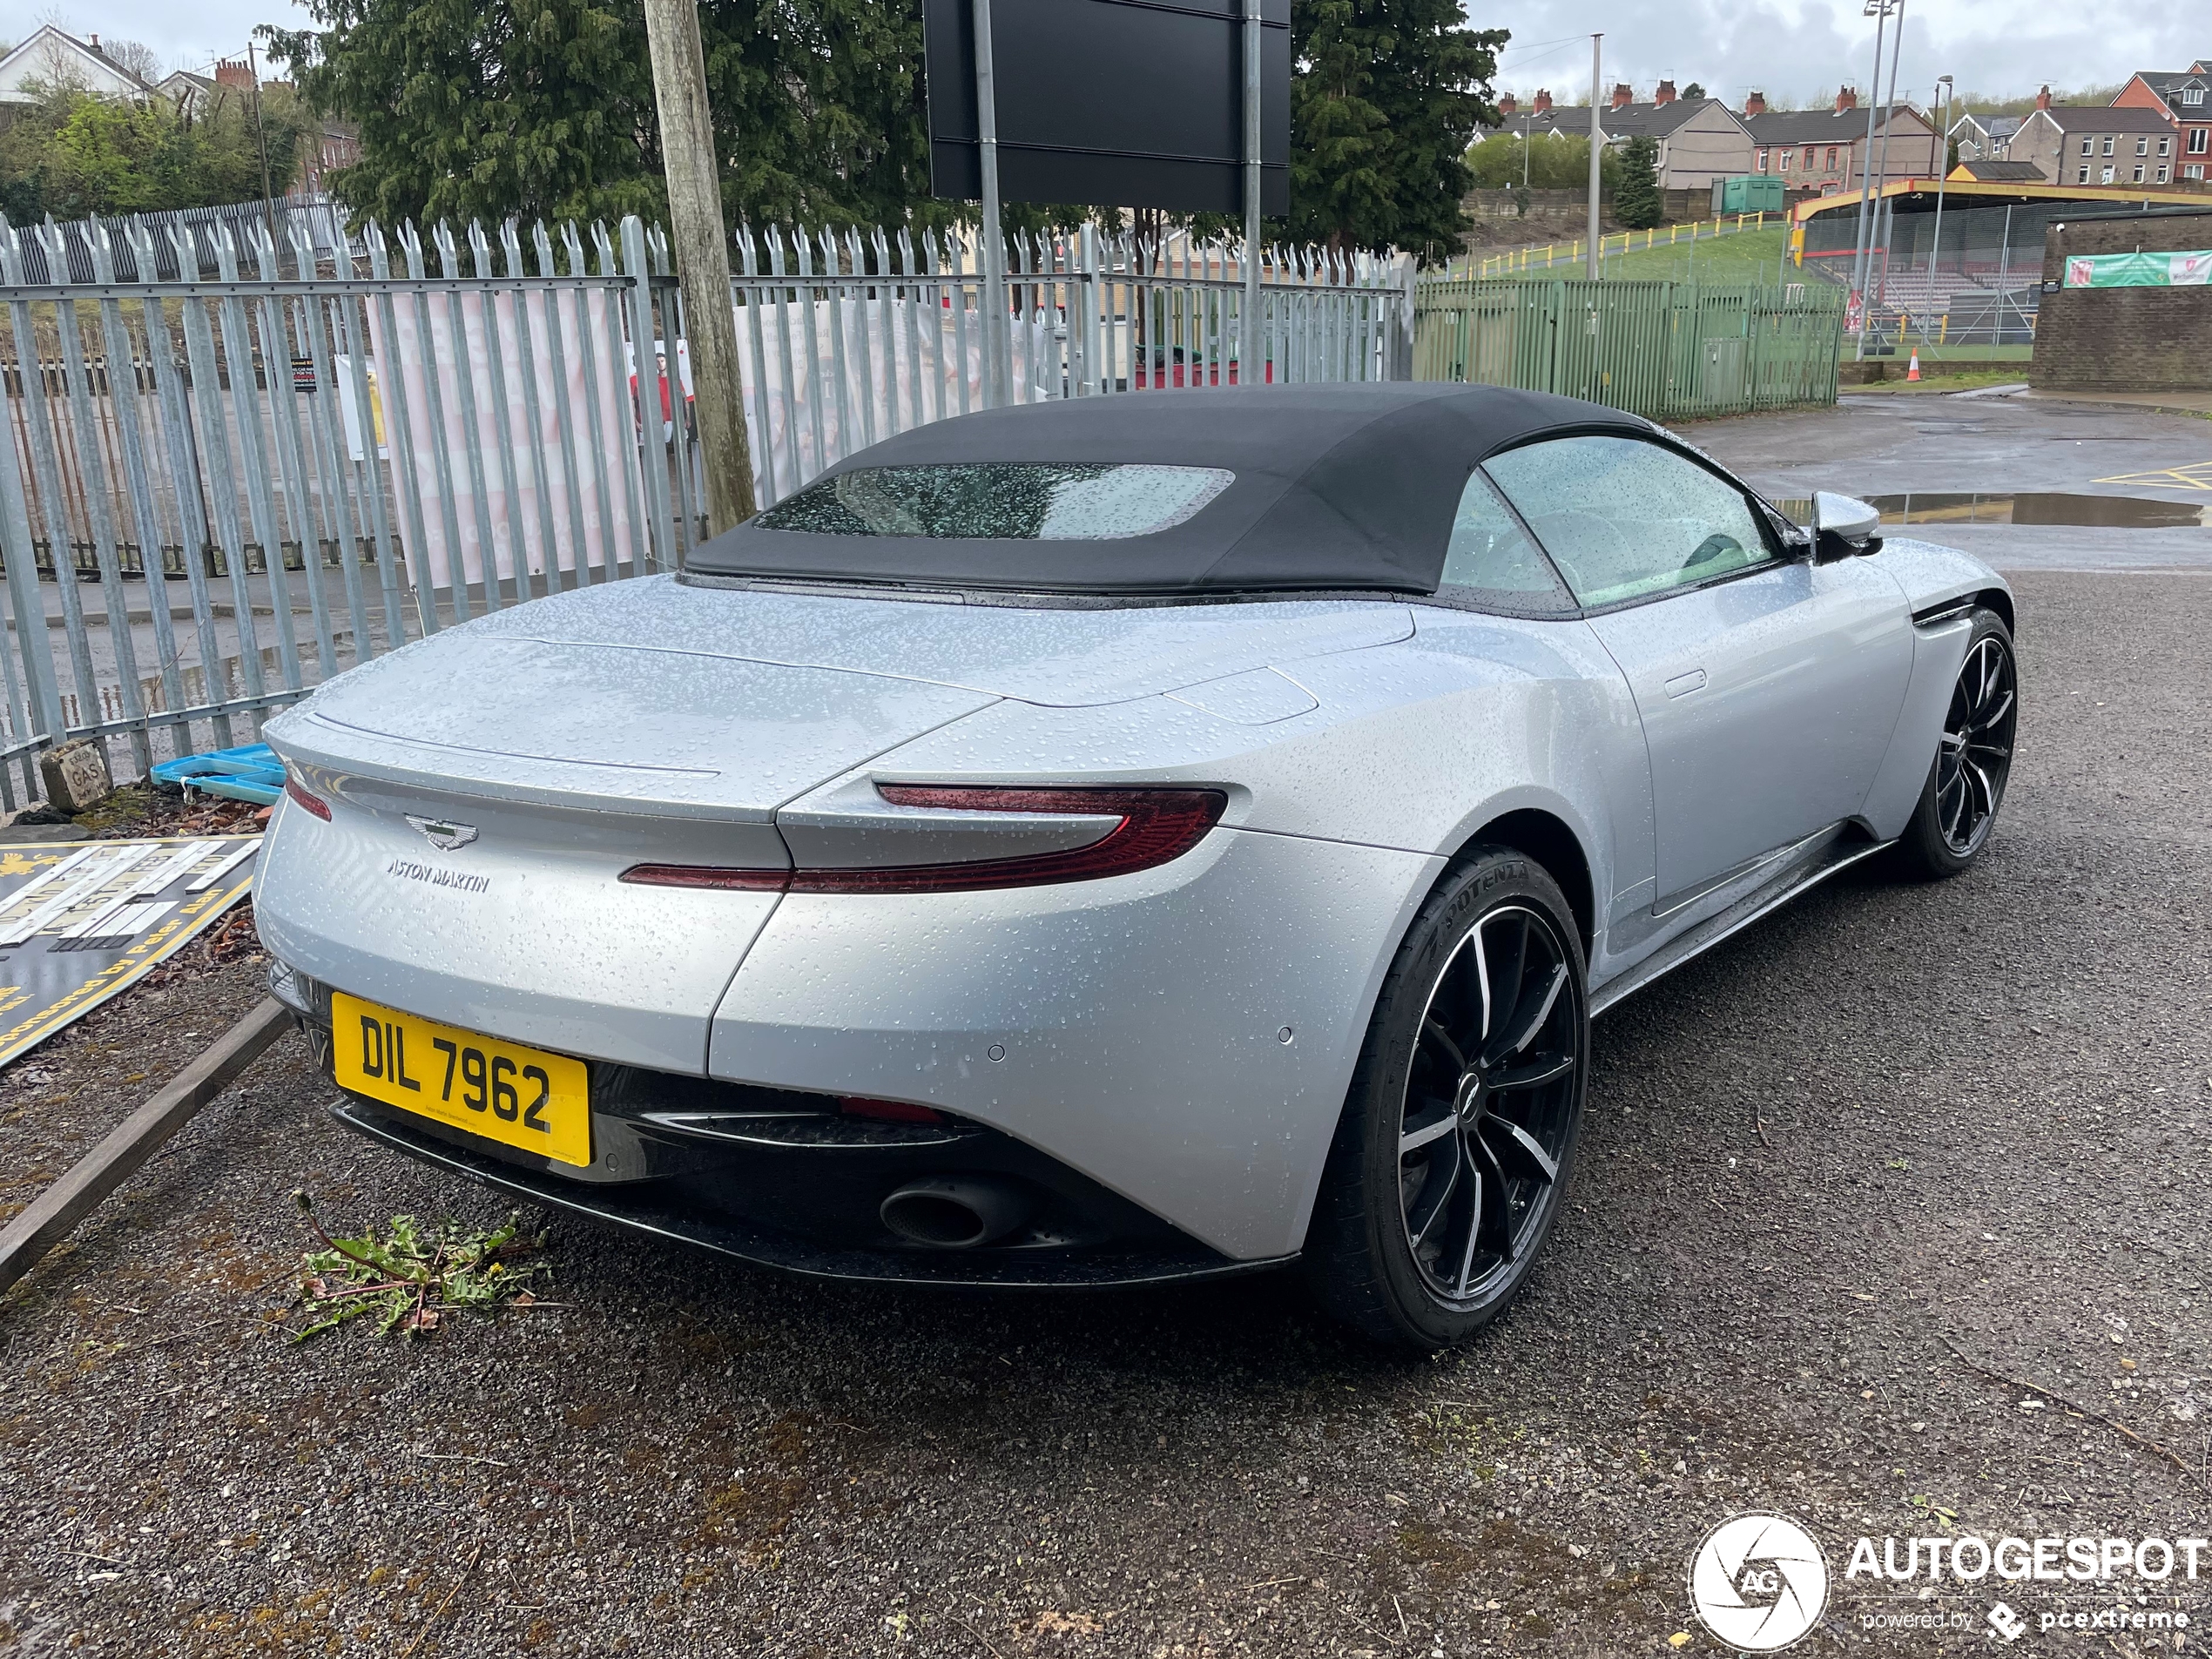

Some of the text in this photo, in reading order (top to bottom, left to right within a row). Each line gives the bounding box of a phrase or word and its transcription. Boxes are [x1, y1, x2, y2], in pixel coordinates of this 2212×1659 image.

[72, 764, 99, 786] GAS
[387, 859, 489, 894] ASTON MARTIN
[1446, 864, 1529, 930] POTENZA
[0, 978, 108, 1047] ponsored
[98, 958, 136, 975] by
[126, 918, 183, 954] Peter
[179, 888, 224, 914] Alan
[361, 1015, 551, 1134] DIL 7962
